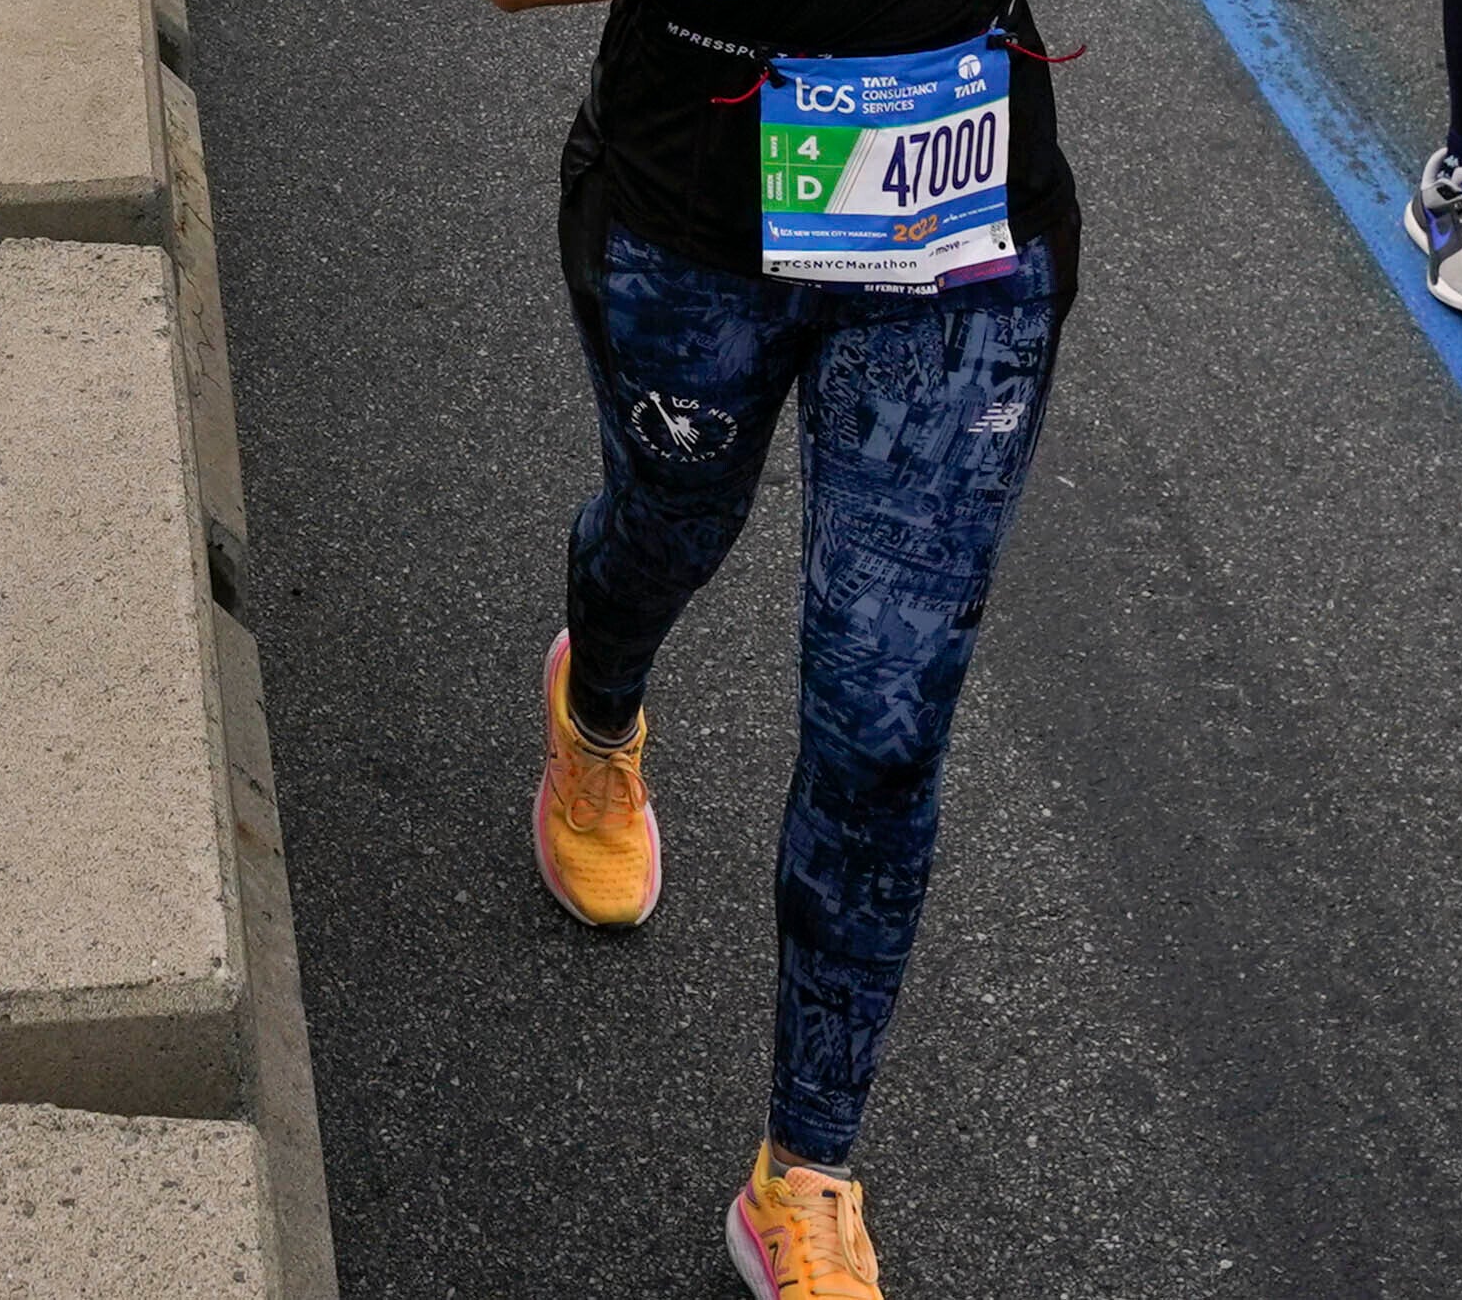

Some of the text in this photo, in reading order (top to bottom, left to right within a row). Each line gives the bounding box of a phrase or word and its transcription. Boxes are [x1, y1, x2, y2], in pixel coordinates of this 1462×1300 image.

[860, 75, 899, 88] TATA
[861, 80, 939, 102] CONSULTANCY
[954, 78, 987, 100] TATA
[795, 76, 856, 115] tcs
[861, 99, 915, 115] SERVICES
[796, 135, 821, 162] 4
[881, 109, 996, 207] 47000
[797, 174, 823, 201] D
[793, 229, 888, 240] NEW YORK CITY MARATHON
[892, 214, 939, 243] 2022
[934, 238, 963, 255] move
[875, 284, 905, 294] FERRY
[671, 395, 700, 410] tcs
[707, 407, 730, 426] NEW
